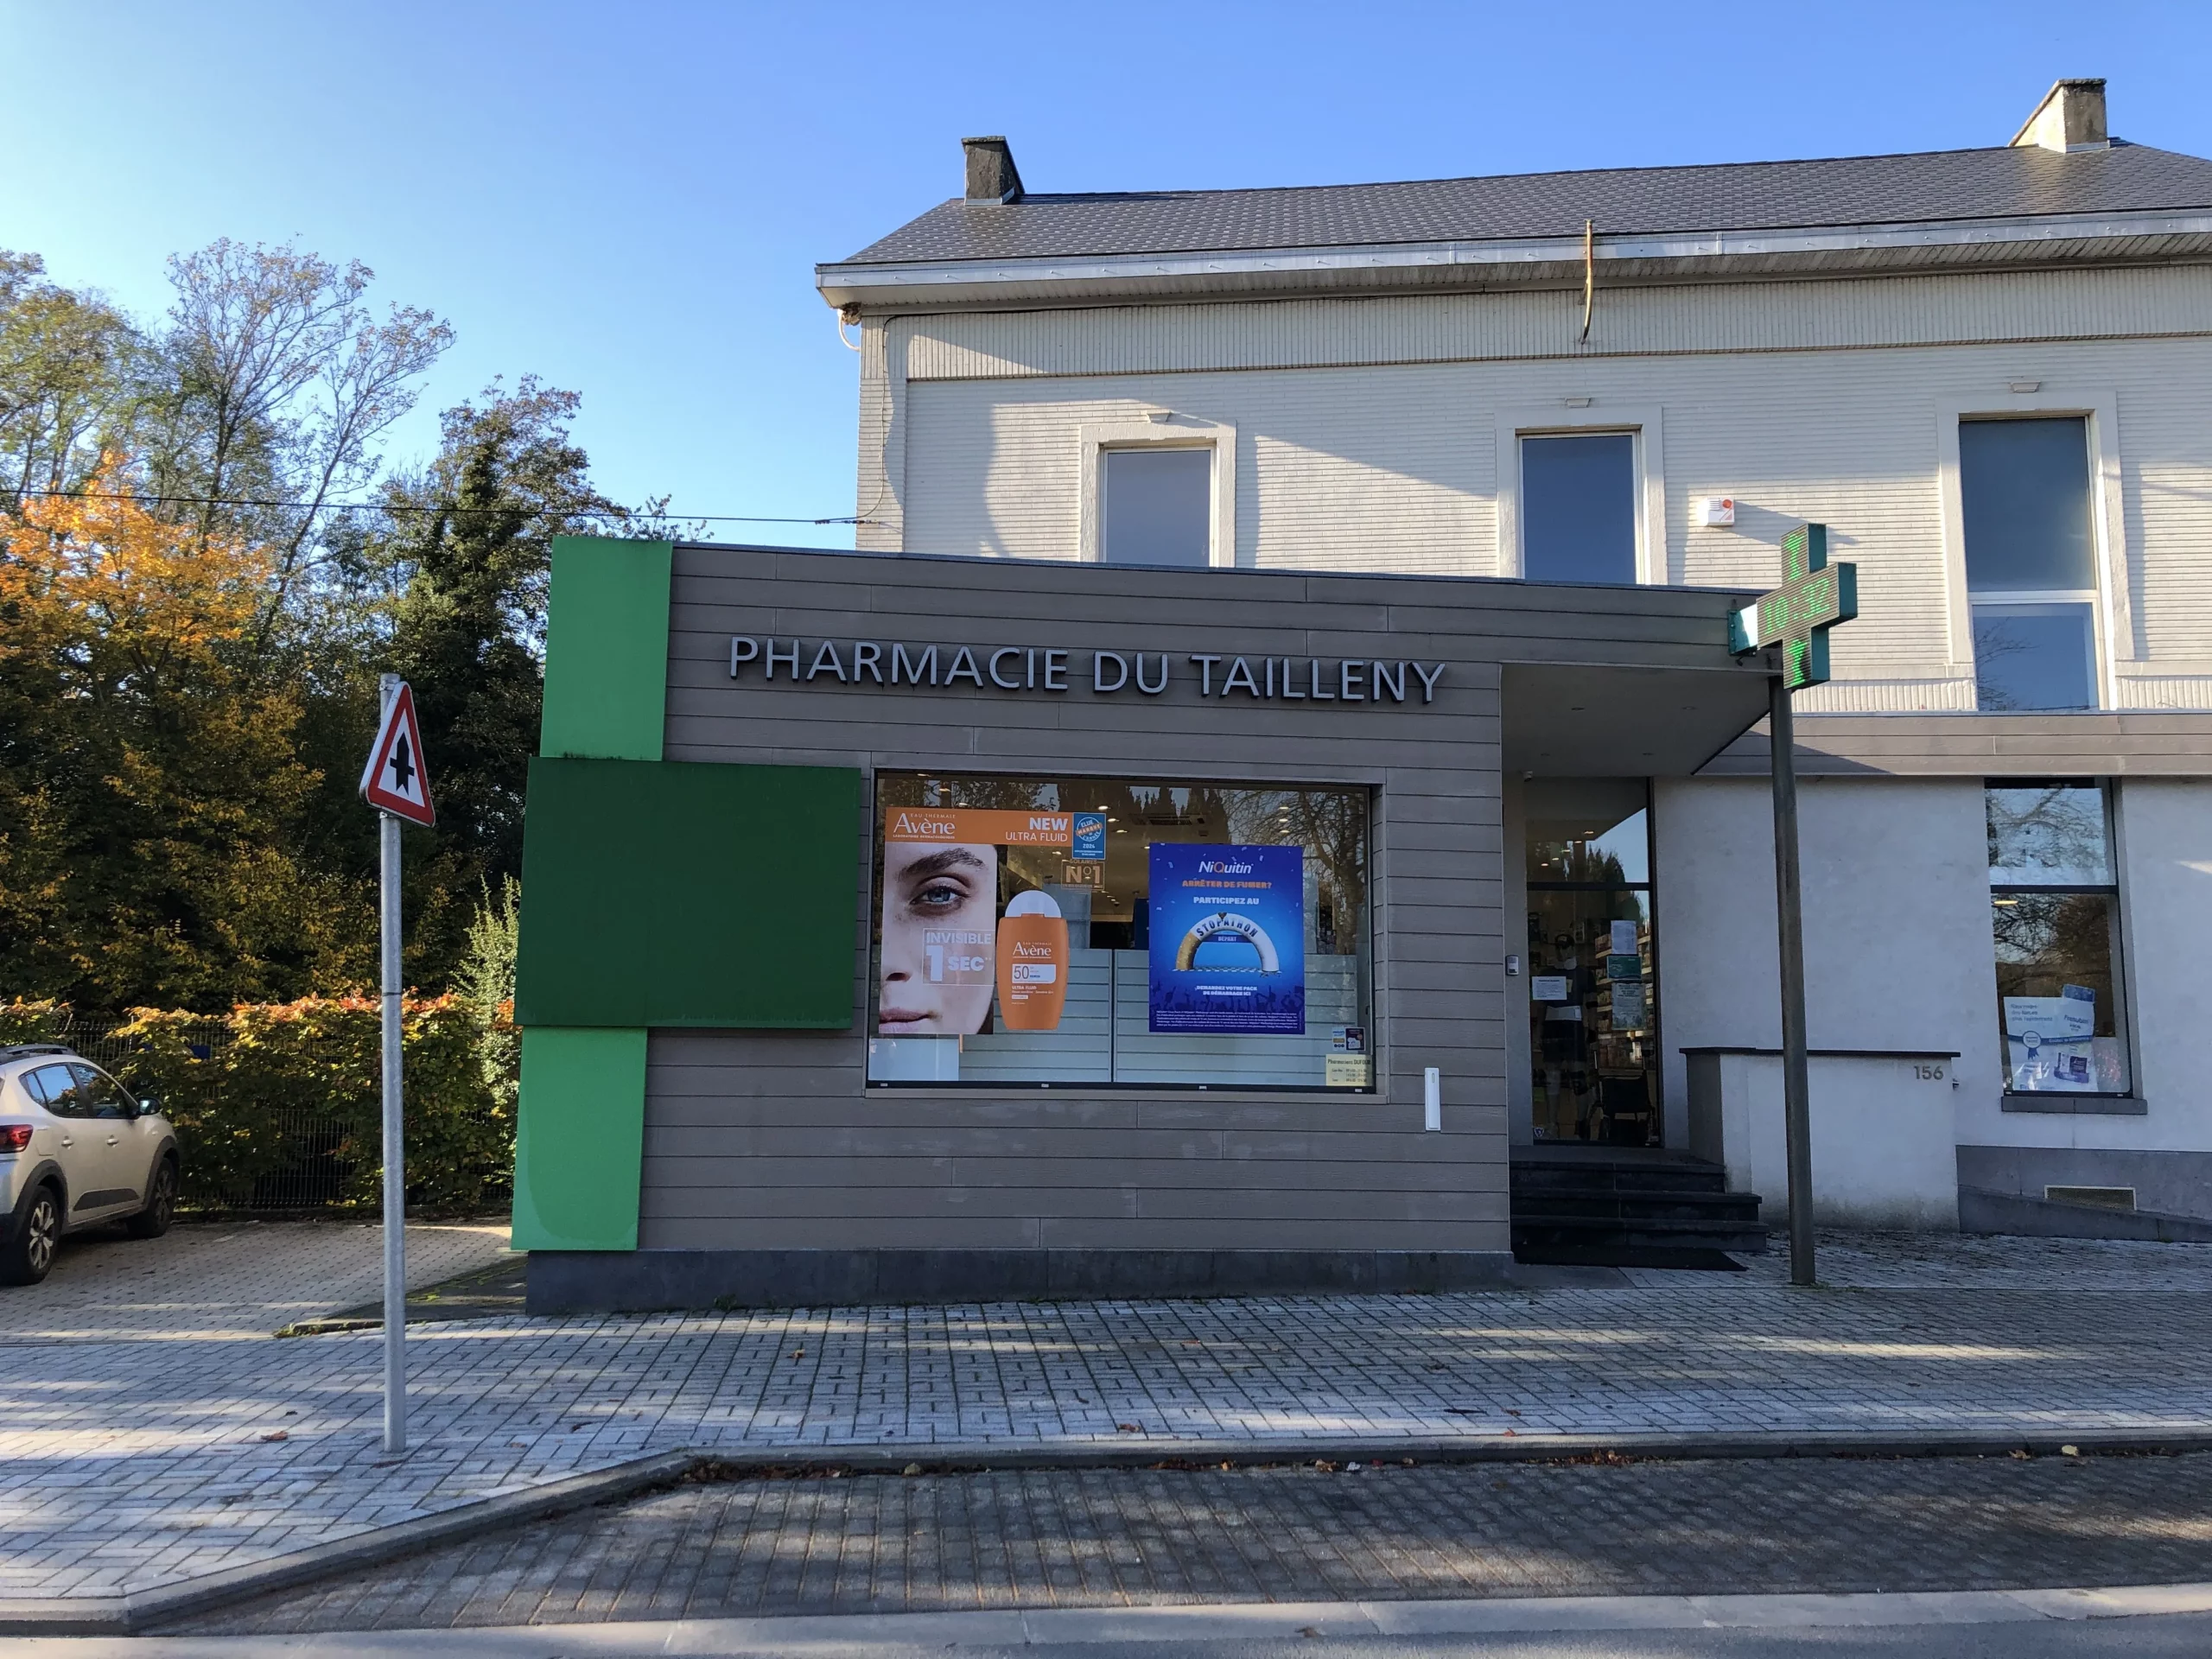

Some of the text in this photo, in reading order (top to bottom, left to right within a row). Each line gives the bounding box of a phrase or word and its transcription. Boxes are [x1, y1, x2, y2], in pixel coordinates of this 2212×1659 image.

[1764, 577, 1830, 635] 10:32
[729, 636, 1446, 704] PHARMACIE DU TAILLENY
[893, 812, 956, 835] Avène
[1029, 817, 1068, 831] NEW
[1005, 831, 1068, 842] ULTRA FLUID
[1182, 879, 1222, 887] ARRÊTER
[1193, 896, 1245, 905] PARTICIPEZ
[1196, 918, 1258, 938] STOPATHON
[926, 931, 992, 944] INVISIBLE
[1012, 941, 1052, 957] Avène
[925, 944, 944, 982] 1
[1014, 965, 1029, 980] 50
[1914, 1065, 1944, 1080] 156
